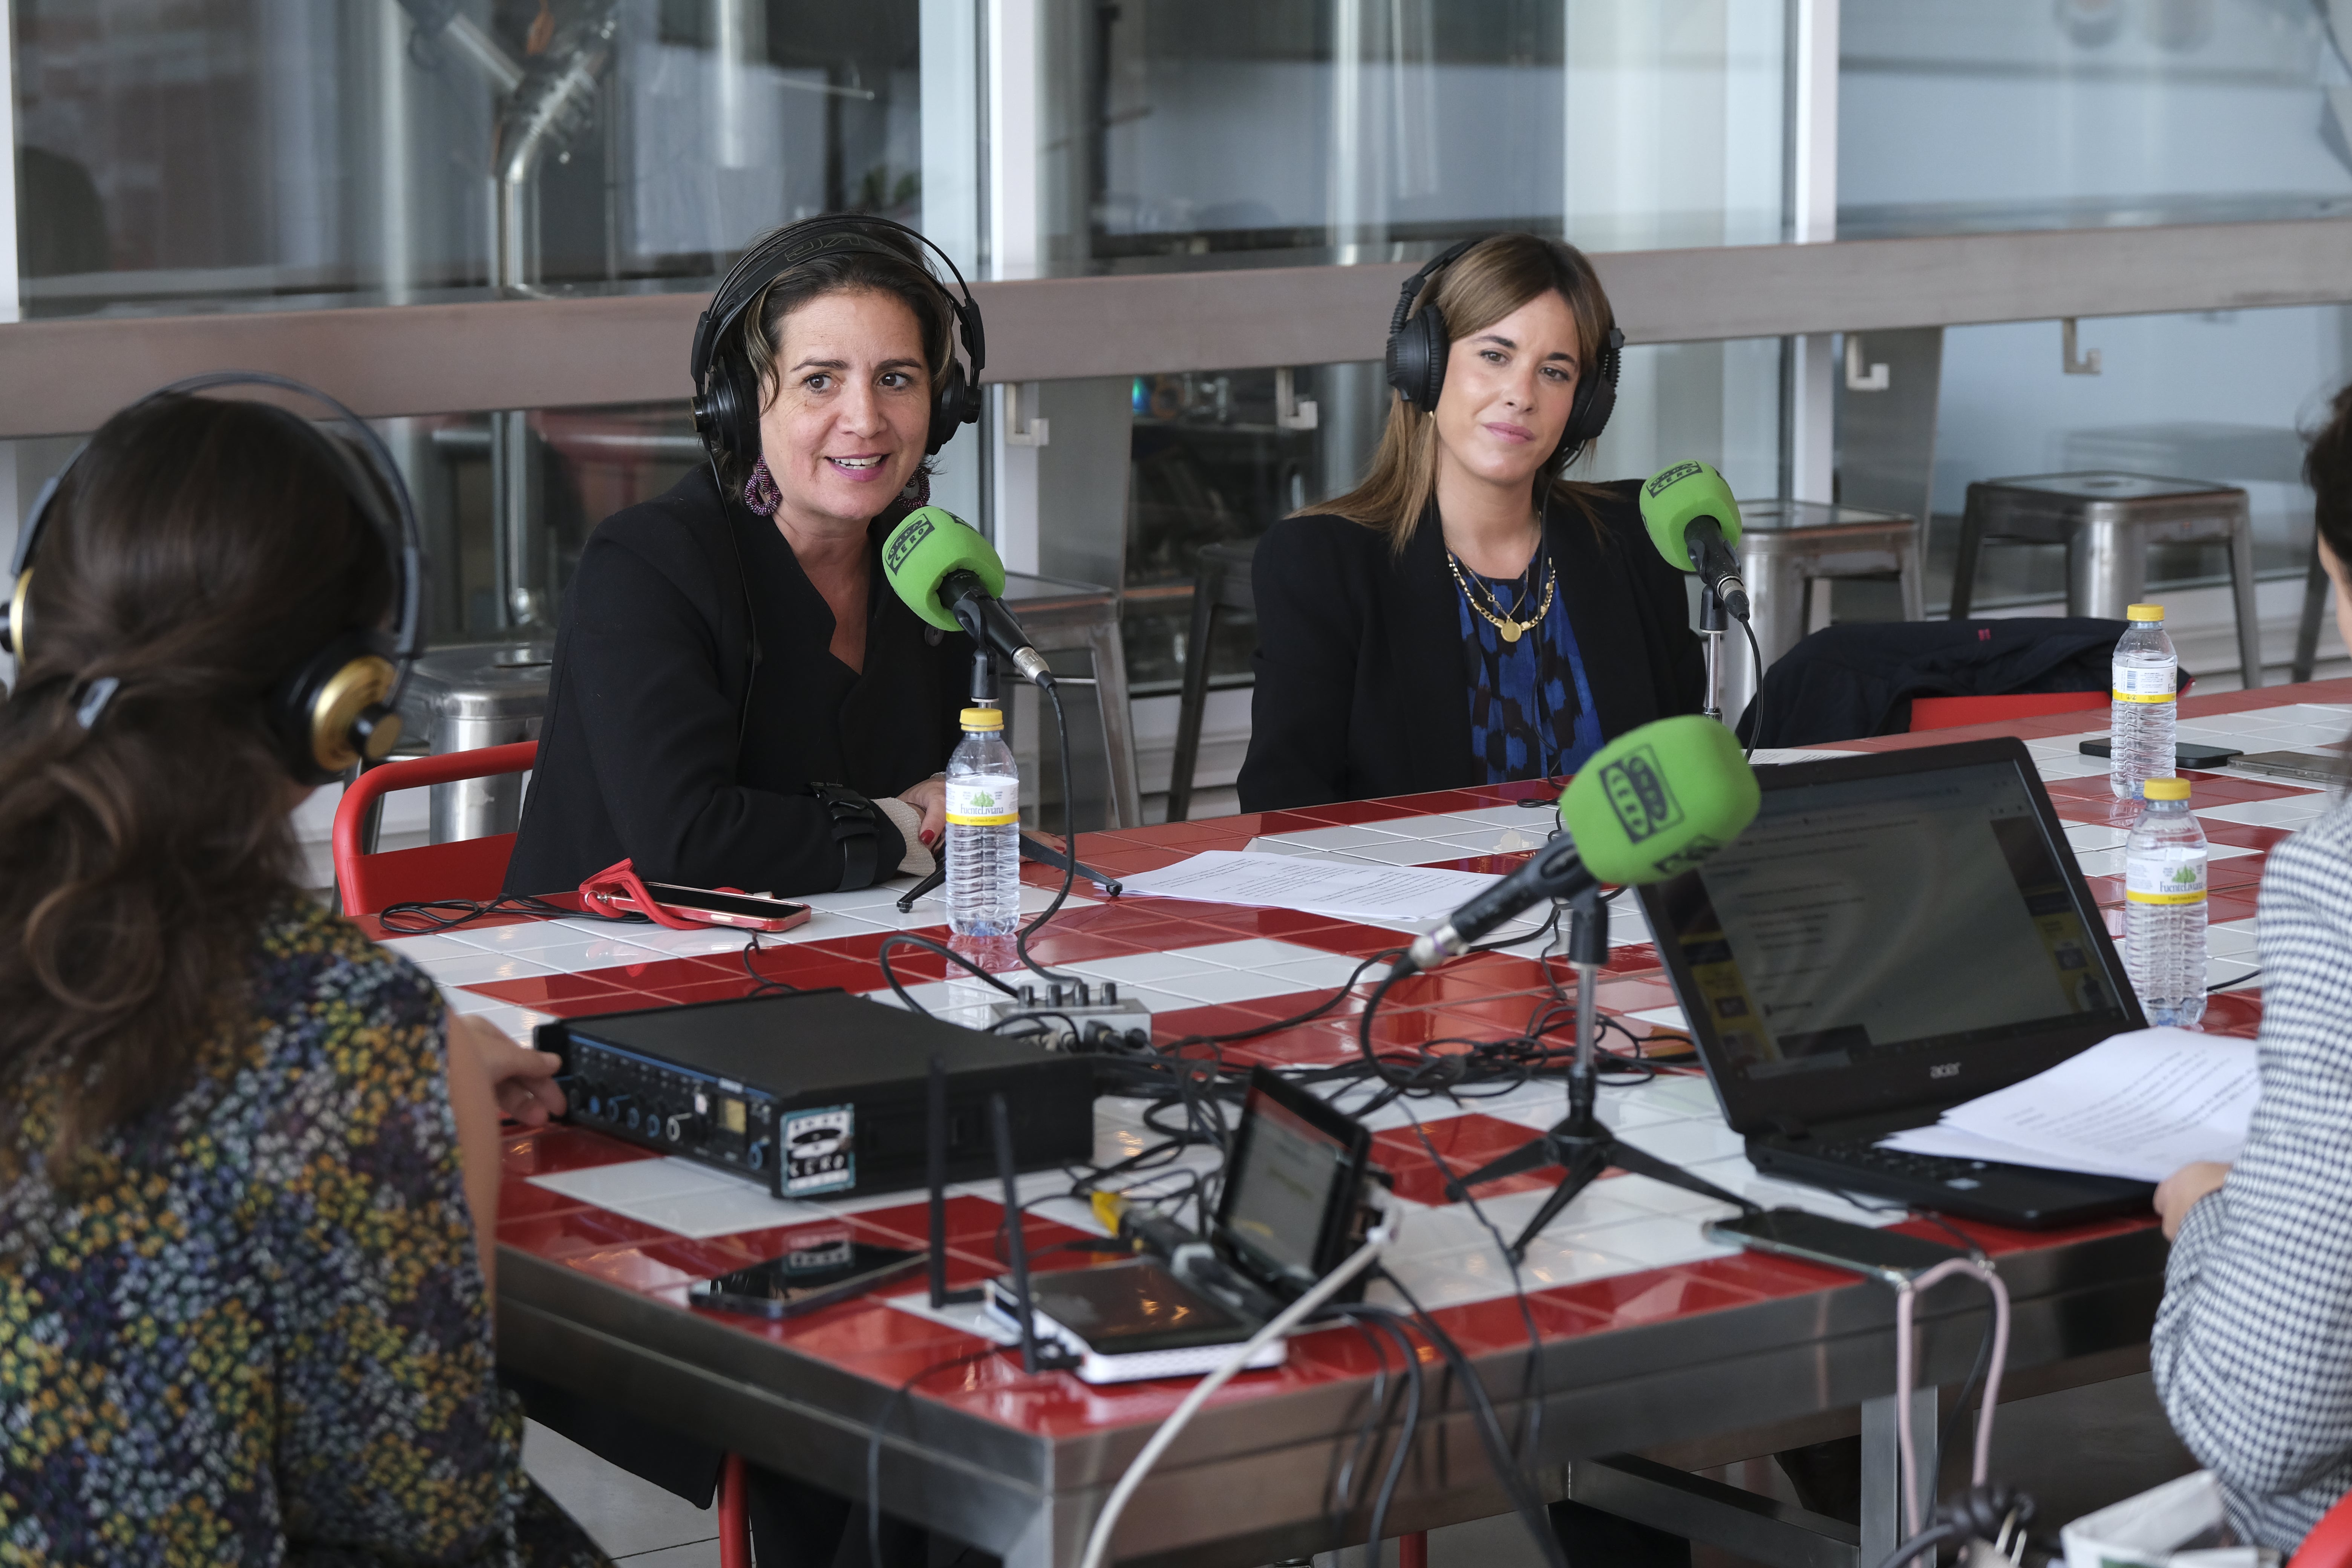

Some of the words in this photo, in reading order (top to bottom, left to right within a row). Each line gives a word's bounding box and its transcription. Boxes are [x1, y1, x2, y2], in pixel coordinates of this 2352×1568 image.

[1652, 465, 1689, 484] ONDA
[1658, 468, 1692, 488] CERO
[890, 524, 919, 555] ONDA
[895, 528, 924, 561] CERO
[1929, 1062, 1961, 1078] acer
